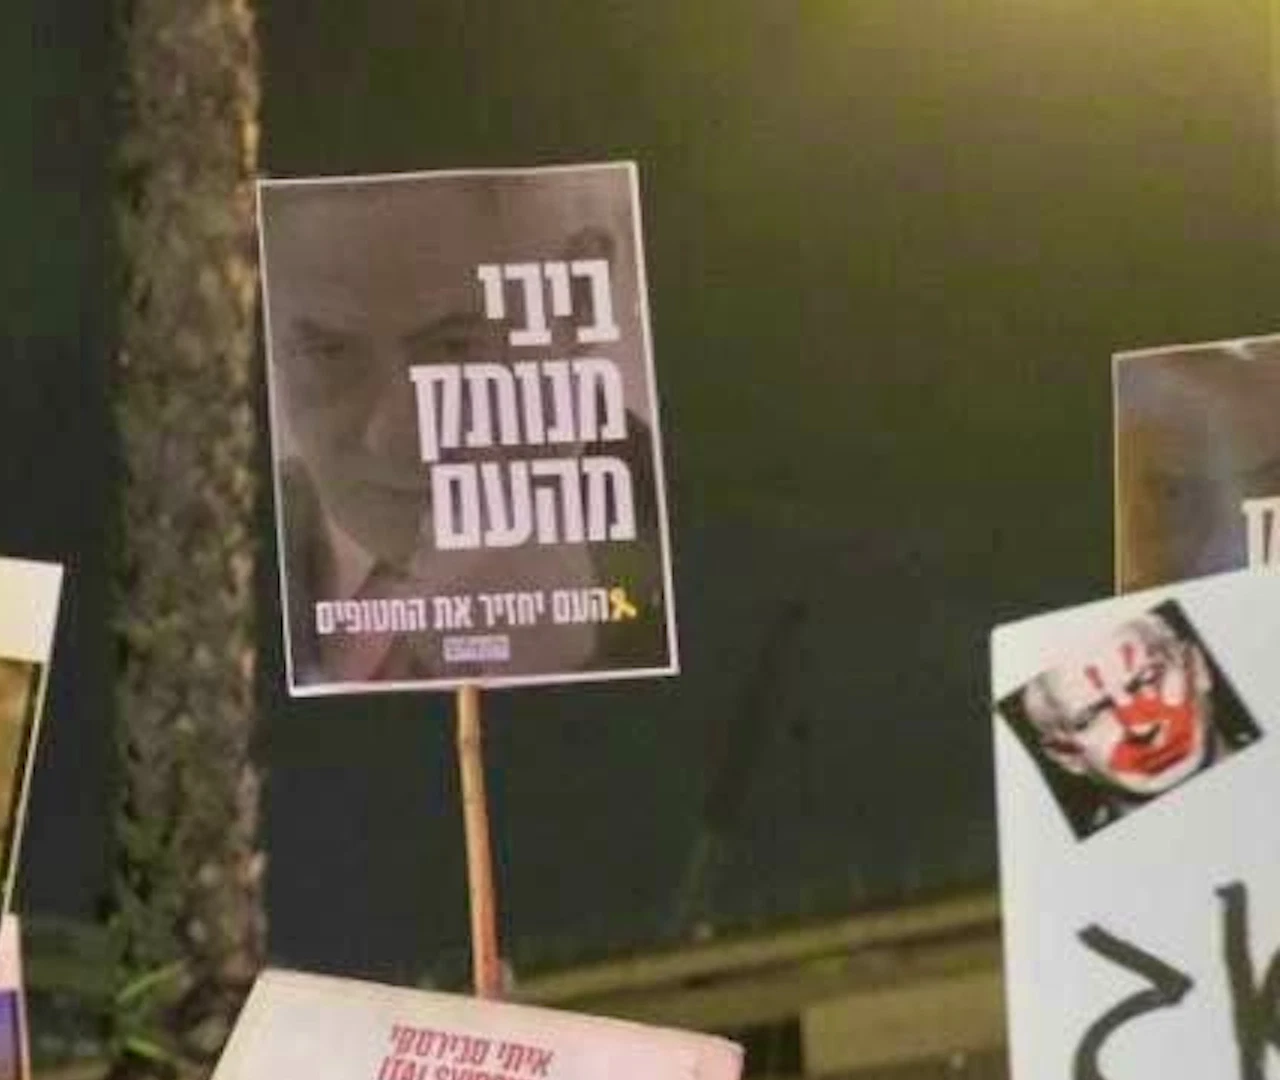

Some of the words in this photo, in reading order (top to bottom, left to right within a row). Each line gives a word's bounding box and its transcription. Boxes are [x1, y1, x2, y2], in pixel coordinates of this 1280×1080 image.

[477, 259, 621, 348] ביבי
[408, 357, 628, 463] מנותק
[429, 456, 637, 551] מהעם
[315, 598, 426, 635] החטופים
[432, 593, 473, 629] את
[478, 591, 544, 627] יחזיר
[552, 588, 610, 625] העם
